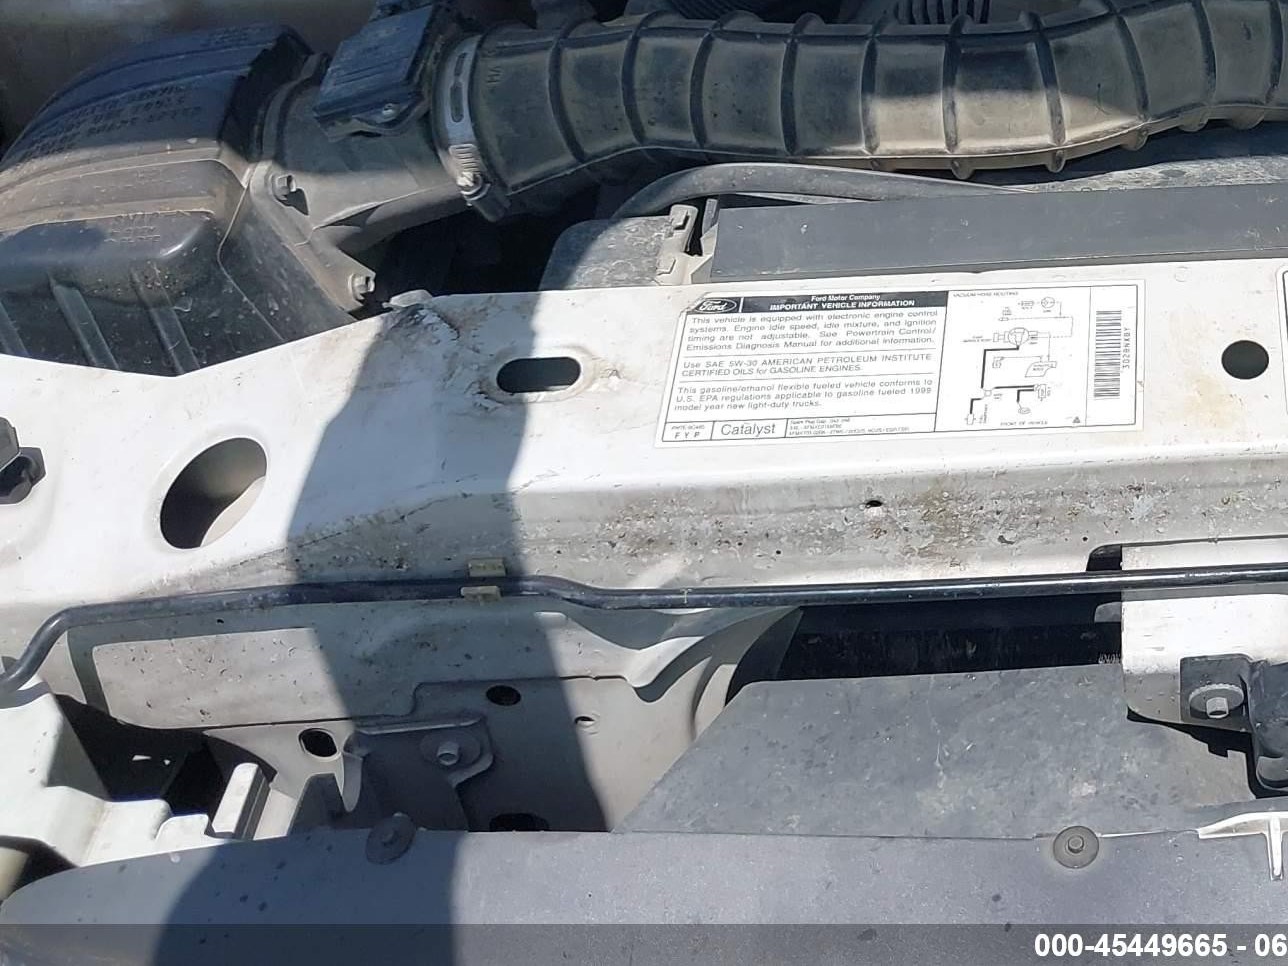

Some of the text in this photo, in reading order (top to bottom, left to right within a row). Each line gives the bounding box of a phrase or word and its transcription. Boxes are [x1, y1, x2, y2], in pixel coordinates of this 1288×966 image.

[697, 299, 729, 312] Ford
[769, 302, 818, 310] IMPORTANT
[733, 324, 766, 332] Engine
[767, 323, 786, 331] idle
[846, 329, 895, 337] Powertrain
[686, 343, 733, 351] Emissions
[735, 342, 780, 350] Diagnosis
[783, 340, 817, 348] Manual
[836, 338, 879, 346] additional
[705, 360, 725, 368] SAE
[761, 357, 813, 366] AMERICAN
[817, 355, 877, 364] PETROLEUM
[881, 353, 932, 362] INSTITUTE
[681, 368, 731, 377] CERTIFIED
[769, 365, 817, 374] GASOLINE
[677, 386, 697, 394] This
[777, 383, 810, 391] flexible
[699, 394, 719, 402] EPA
[721, 393, 772, 402] regulations
[775, 391, 822, 400] applicable
[747, 401, 790, 409] light-duty
[720, 422, 777, 435] Catalyst
